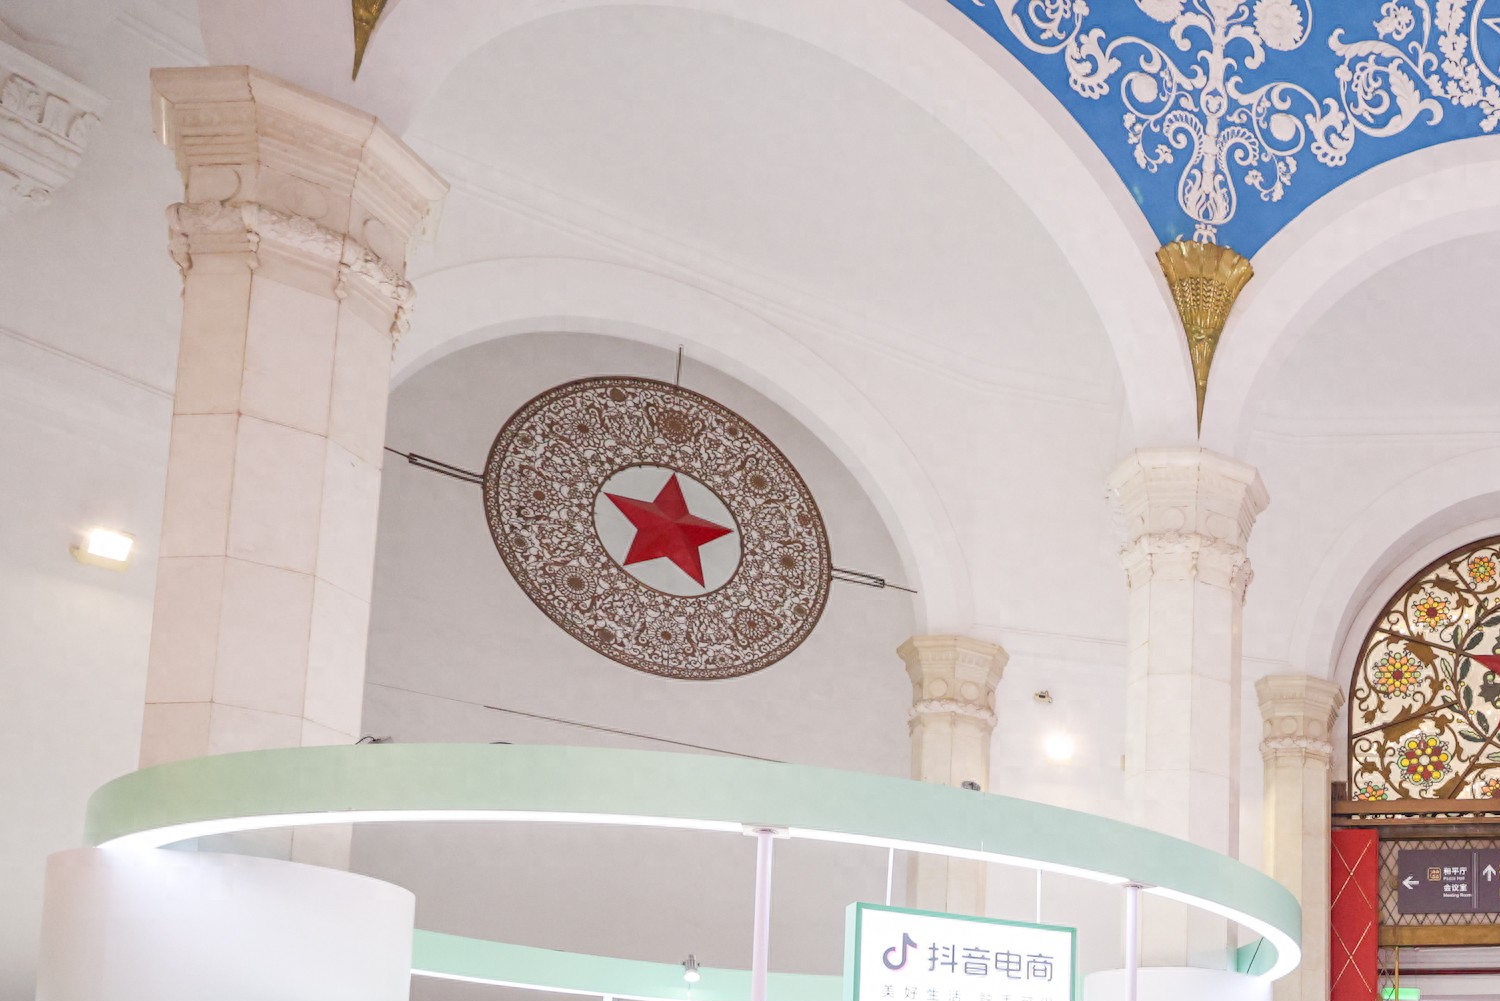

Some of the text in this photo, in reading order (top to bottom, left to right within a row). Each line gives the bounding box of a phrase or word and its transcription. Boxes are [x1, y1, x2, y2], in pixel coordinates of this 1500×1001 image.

[1443, 884, 1468, 892] 会议室
[928, 942, 1054, 982] 抖音电商
